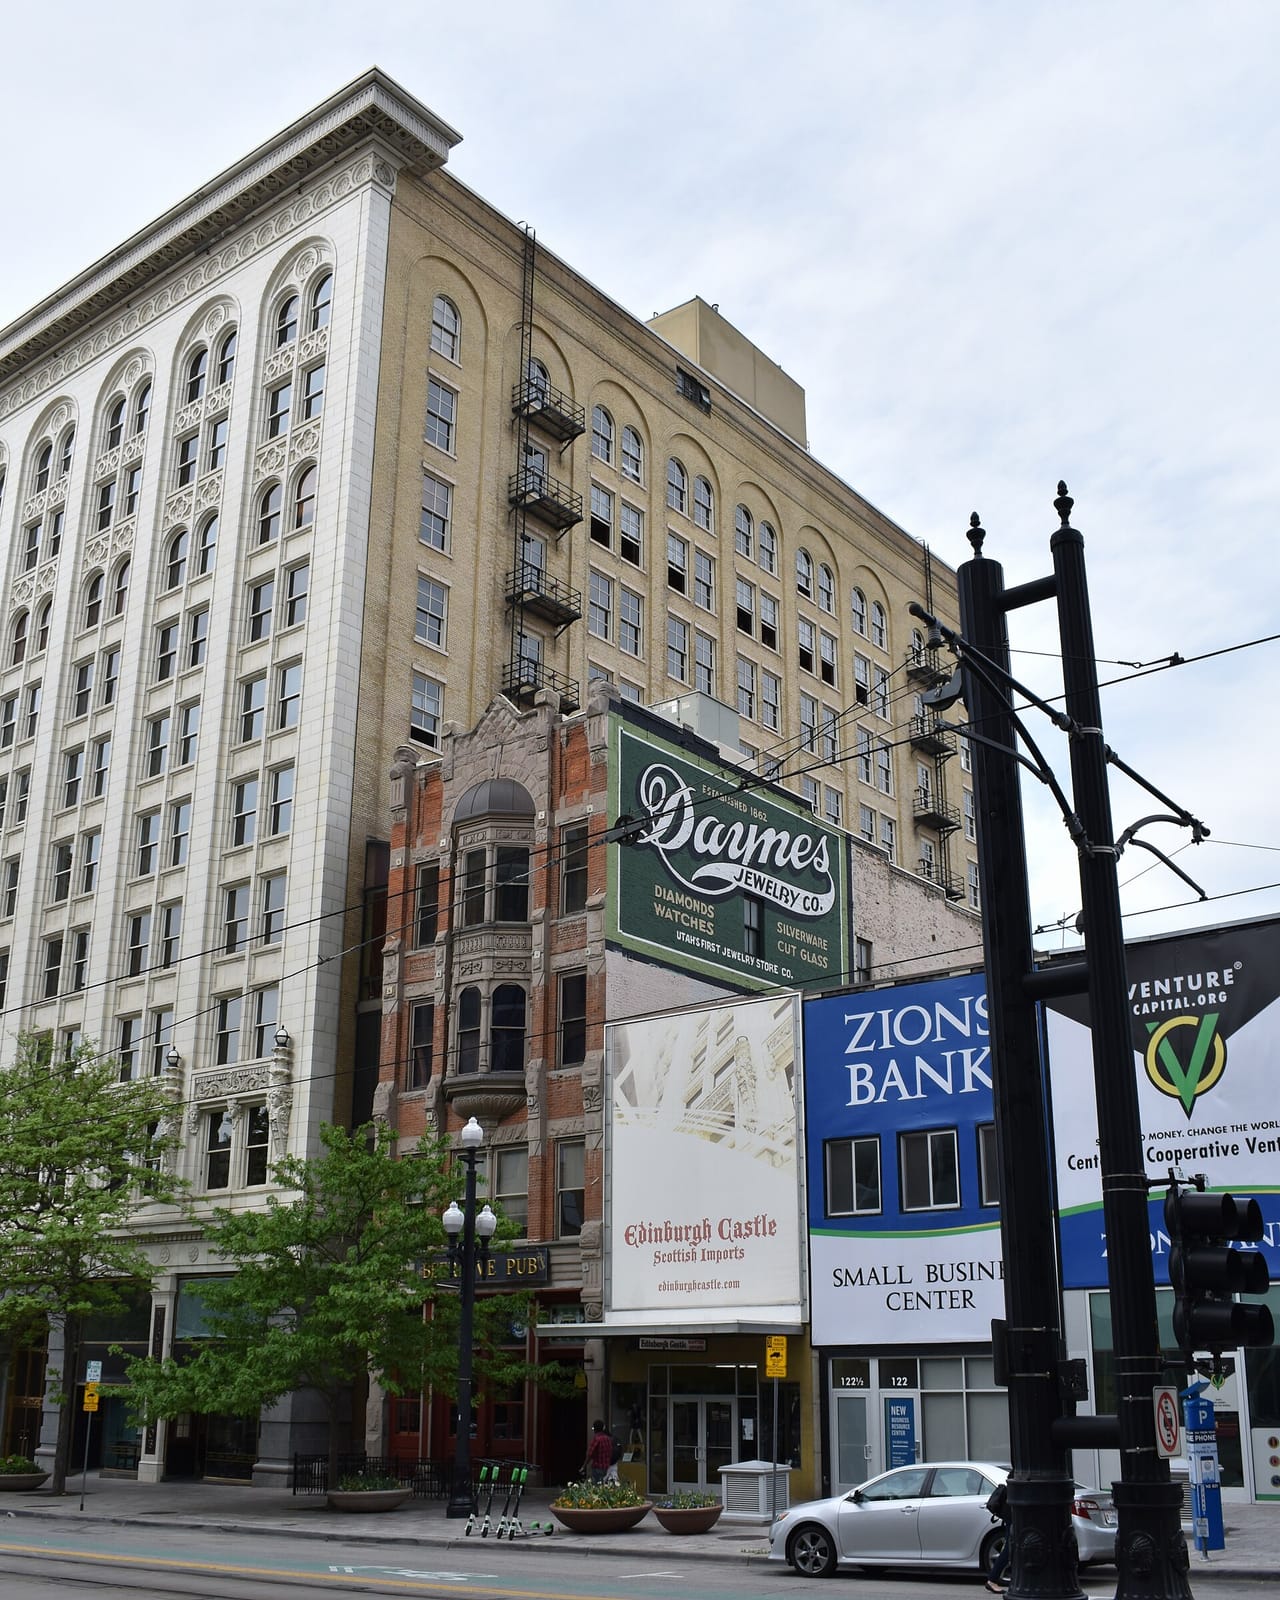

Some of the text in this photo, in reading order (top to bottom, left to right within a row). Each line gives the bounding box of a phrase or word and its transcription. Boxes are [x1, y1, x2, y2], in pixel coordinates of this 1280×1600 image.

[750, 806, 768, 822] 1862
[654, 884, 715, 918] DIAMONDS
[733, 868, 823, 912] JEWELRY CO.
[653, 902, 715, 936] WATCHES
[777, 921, 828, 951] SILVERWARE
[676, 930, 794, 980] UTAH'S FIRST JEWELRY STORE CO.
[777, 940, 828, 969] CUT GLASS
[1128, 968, 1234, 1001] VENTURE
[1133, 991, 1227, 1015] CAPITAL.ORG
[844, 993, 990, 1054] ZIONS
[845, 1046, 992, 1106] BANK
[1148, 1129, 1185, 1141] MONEY.
[1187, 1125, 1227, 1137] CHANGE
[1230, 1123, 1248, 1133] THE
[1250, 1120, 1280, 1130] WORL
[1067, 1154, 1100, 1171] Cent
[1146, 1140, 1240, 1166] Cooperative
[624, 1213, 777, 1248] Edinburgh Castle
[506, 1257, 538, 1276] PUB
[653, 1246, 745, 1267] Scottish Imports
[658, 1278, 740, 1293] edinburghcastle.com
[832, 1260, 1006, 1288] SMALL BUSINE
[886, 1289, 976, 1311] CENTER
[891, 1376, 908, 1386] 122
[891, 1405, 907, 1416] NEW
[1199, 1410, 1208, 1425] P
[1194, 1434, 1217, 1442] PHONE
